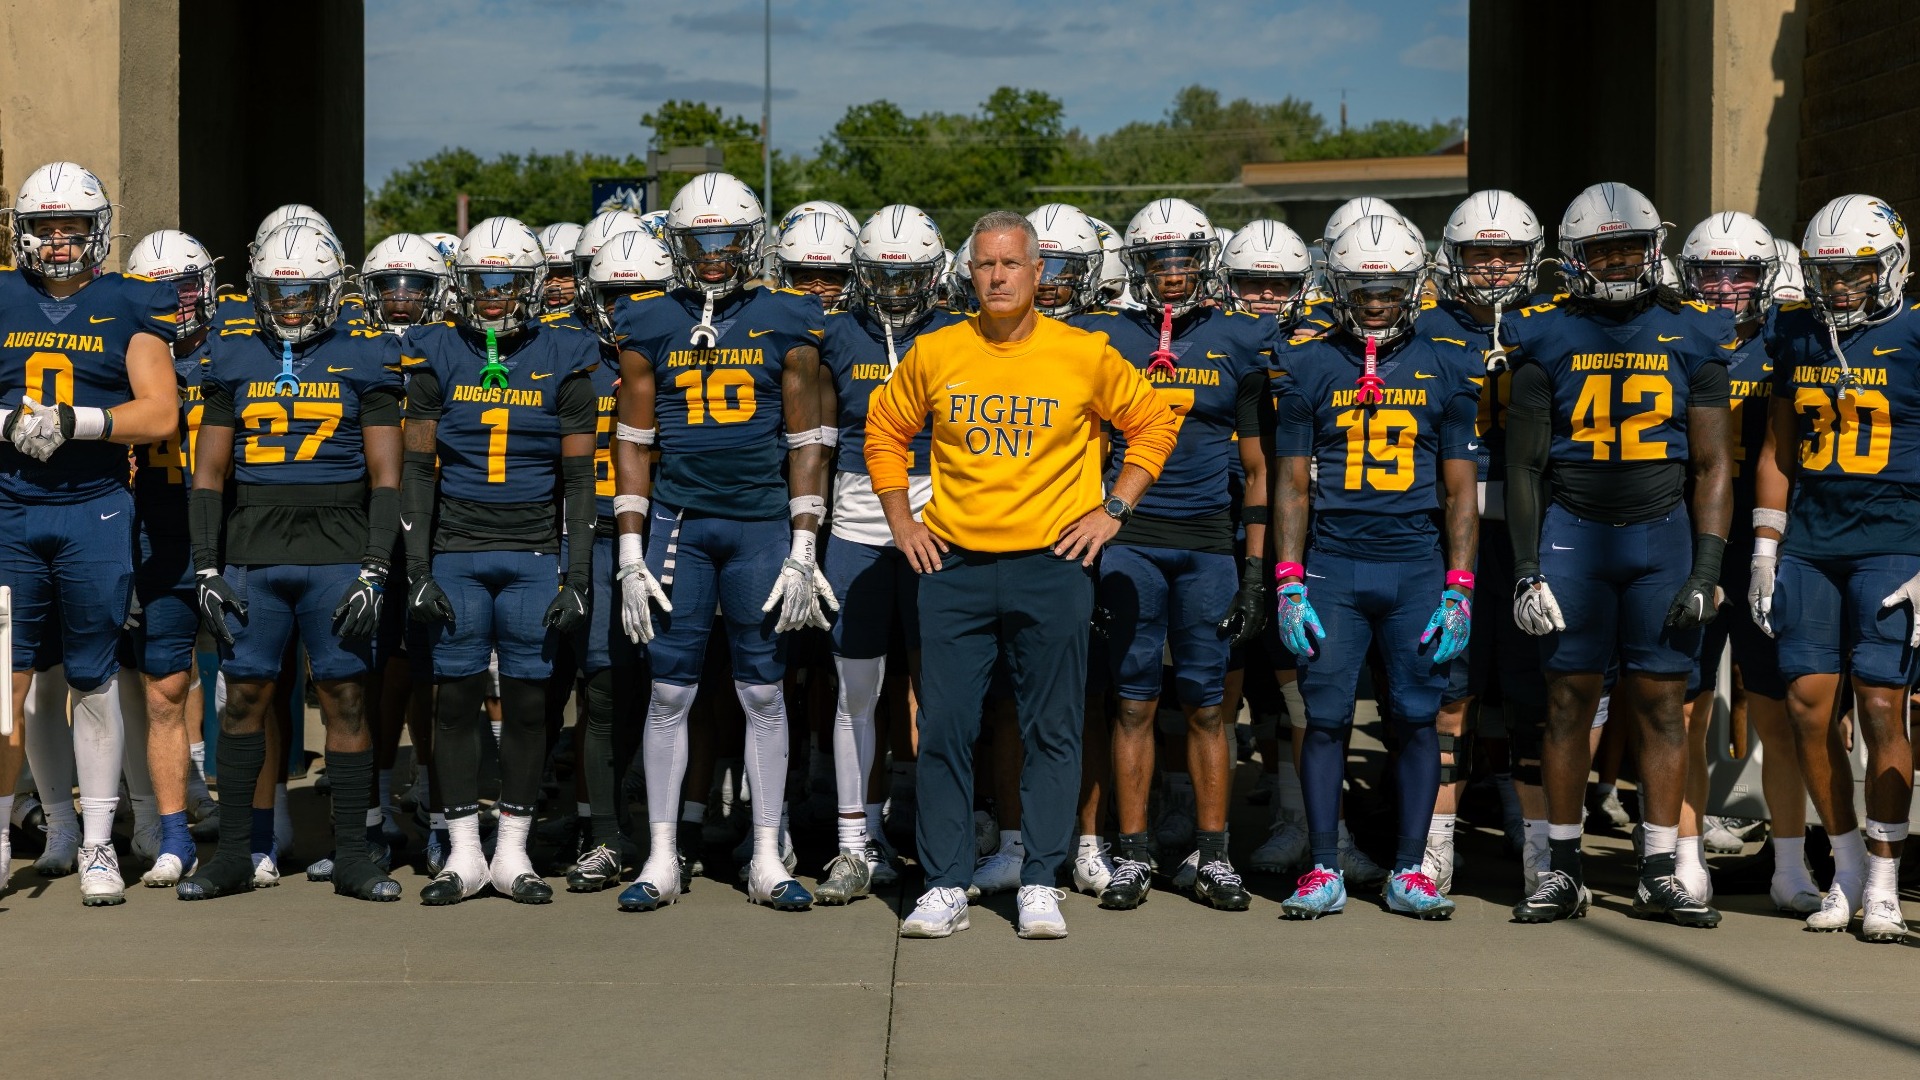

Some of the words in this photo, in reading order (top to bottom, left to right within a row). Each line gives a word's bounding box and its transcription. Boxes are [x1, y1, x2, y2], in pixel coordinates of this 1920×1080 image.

[1154, 233, 1181, 241] Riddell
[1600, 223, 1627, 232] Riddell
[1818, 247, 1845, 255] Riddell
[149, 268, 174, 278] Riddell
[274, 269, 300, 277] Riddell
[480, 259, 505, 267] Riddell
[4, 332, 104, 353] AUGUSTANA
[668, 349, 763, 367] AUGUSTANA
[1571, 352, 1669, 372] AUGUSTANA
[25, 352, 74, 414] 0
[453, 384, 543, 407] AUGUSTANA
[675, 369, 757, 424] 10
[948, 394, 1059, 428] FIGHT
[1571, 374, 1673, 461] 42
[241, 402, 343, 463] 27
[965, 426, 1033, 458] ON!
[1794, 387, 1892, 475] 30
[480, 408, 509, 483] 1
[1335, 409, 1418, 492] 19
[1638, 880, 1651, 904] NIKE
